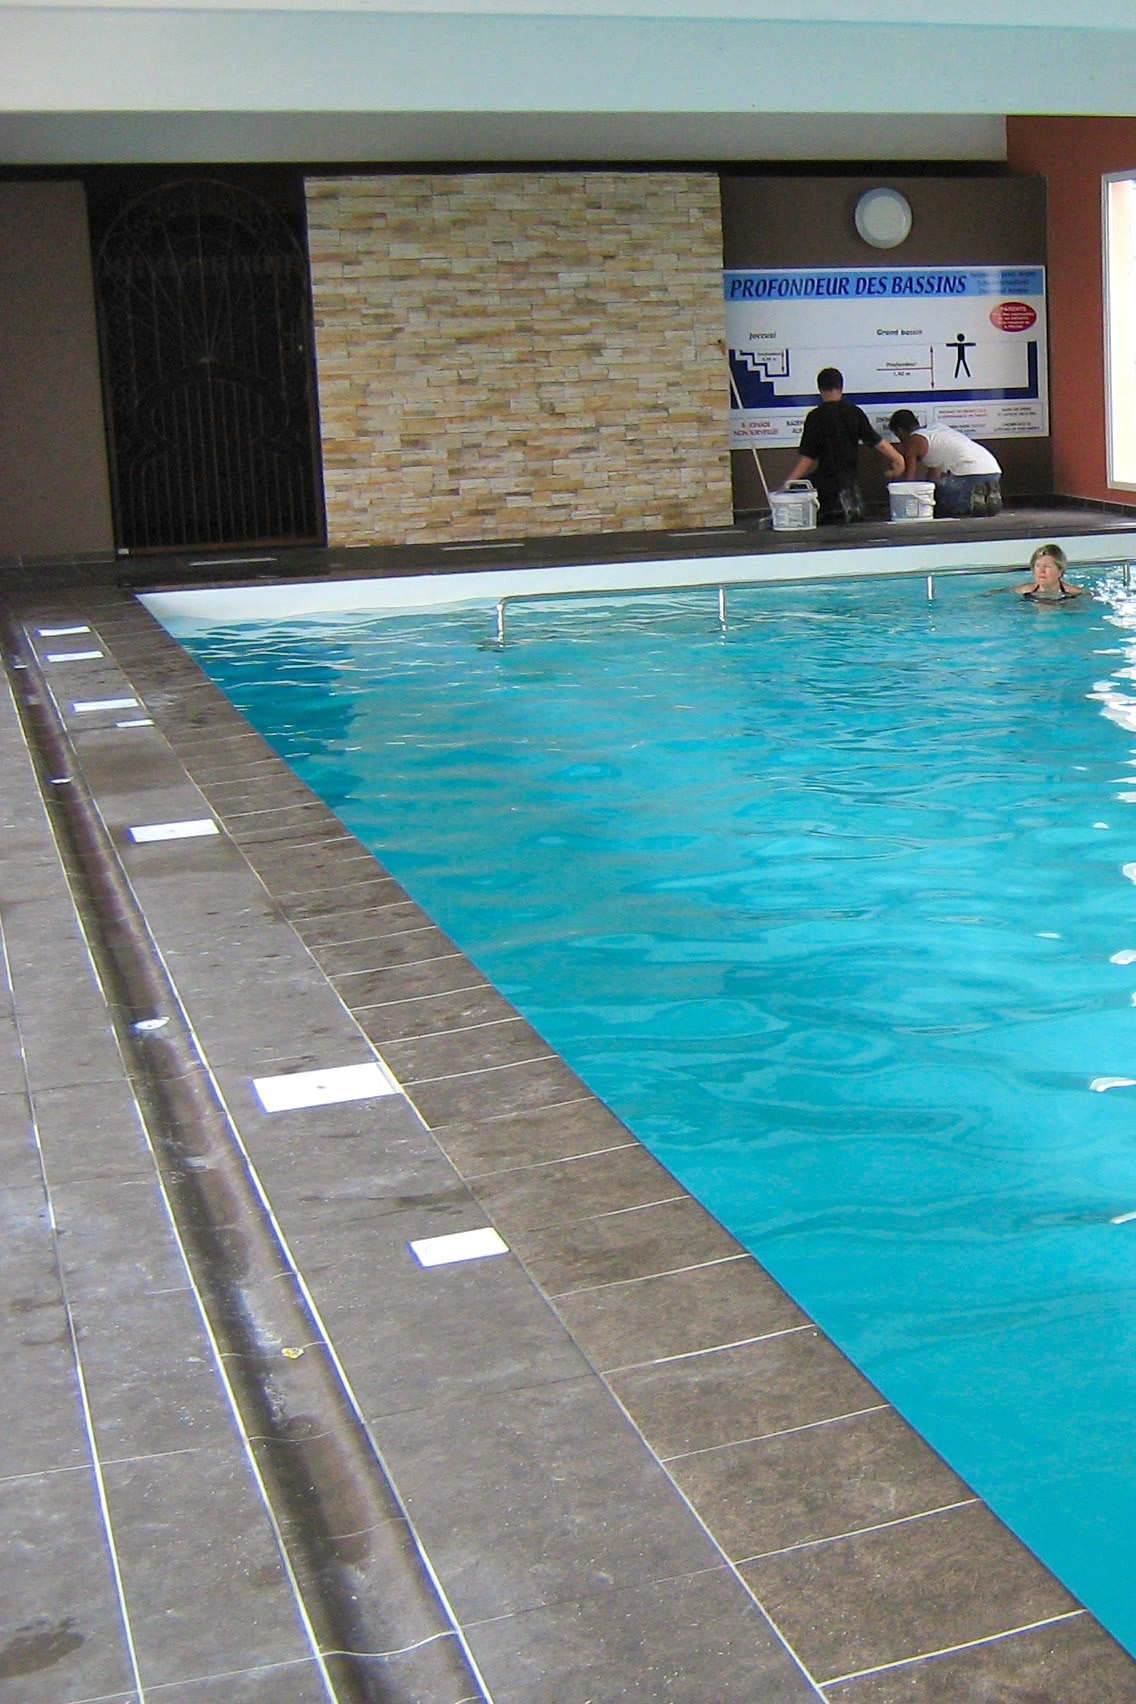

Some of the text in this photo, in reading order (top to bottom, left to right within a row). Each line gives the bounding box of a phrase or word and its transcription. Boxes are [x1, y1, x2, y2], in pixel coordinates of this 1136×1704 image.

[730, 275, 967, 298] PROFONDEUR DES BASSINS
